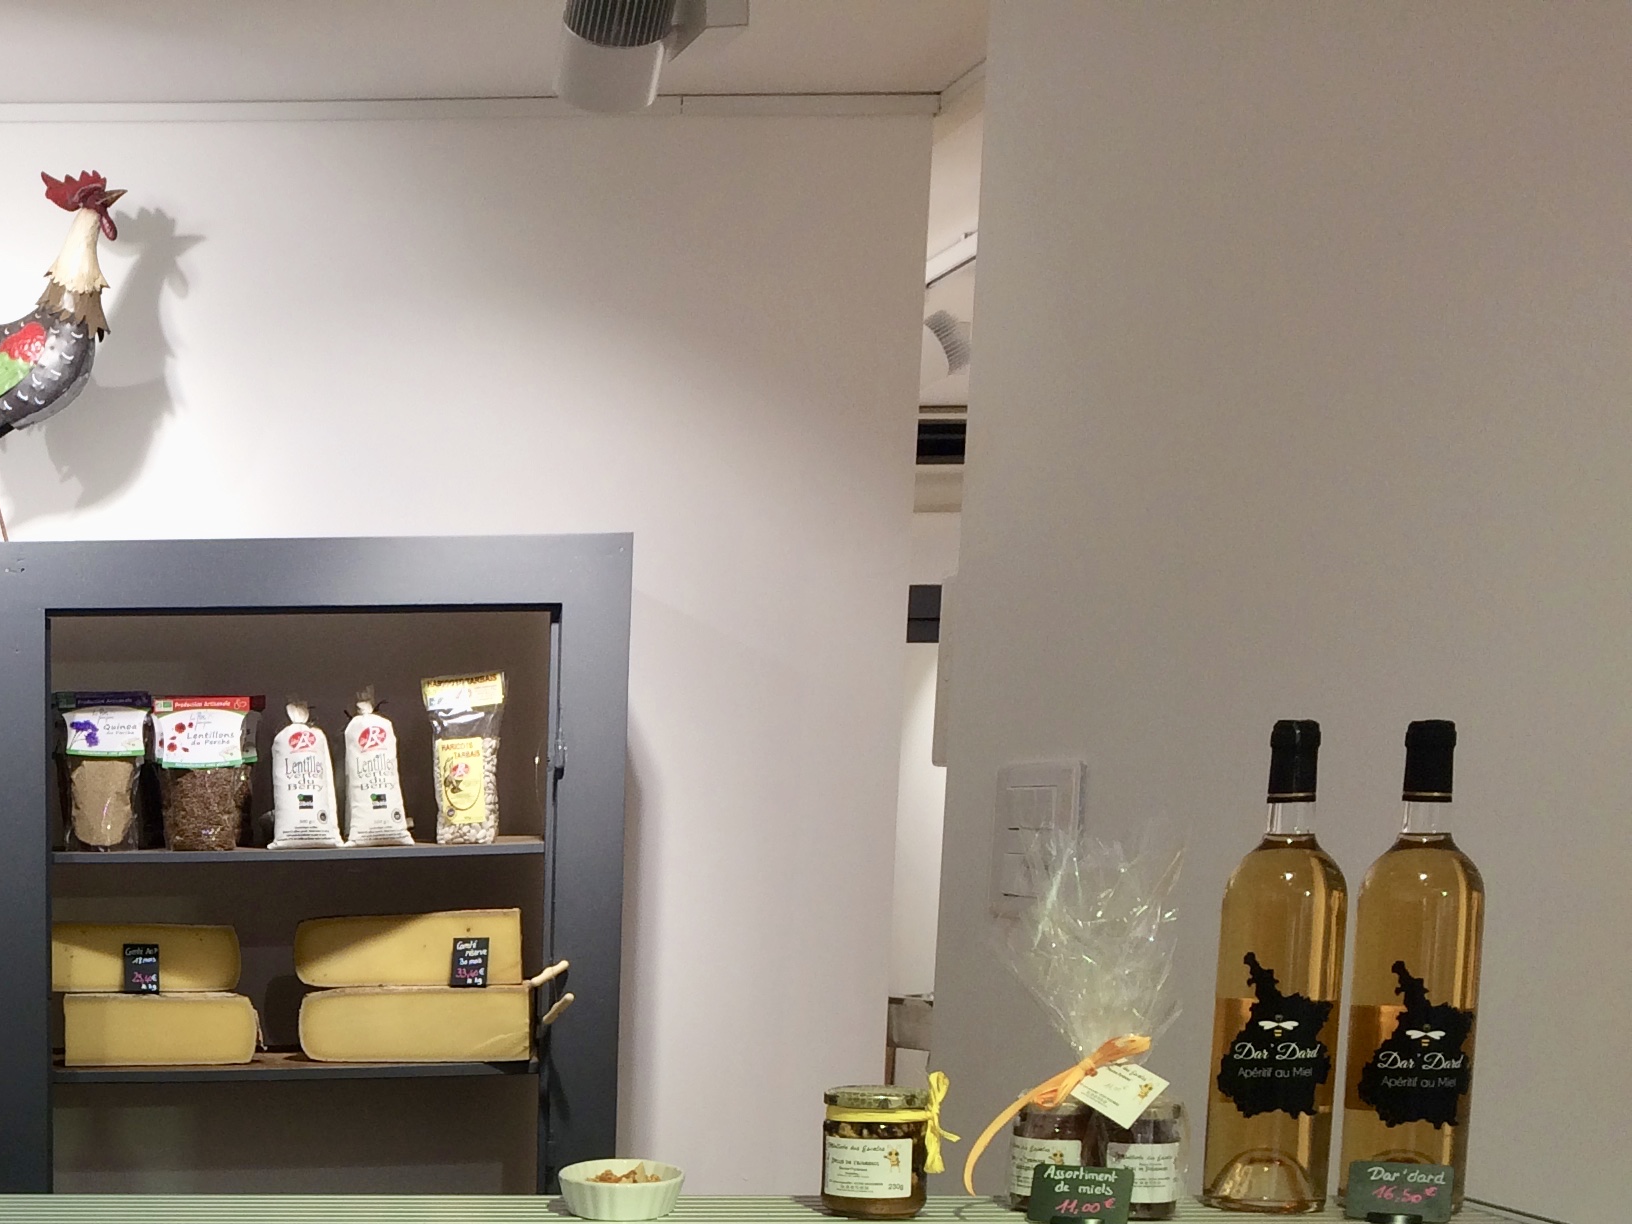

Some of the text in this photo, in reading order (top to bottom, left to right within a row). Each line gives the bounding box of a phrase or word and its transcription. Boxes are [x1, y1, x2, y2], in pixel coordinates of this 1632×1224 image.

[186, 732, 235, 740] Lentillons
[285, 756, 324, 774] Lentilles
[356, 754, 395, 775] Lentilles
[287, 783, 324, 791] Berry
[1276, 1042, 1321, 1060] Dard
[1421, 1052, 1464, 1070] Dard
[1238, 1066, 1312, 1079] Apéritif au Miel
[1381, 1076, 1456, 1088] Apéritif au Miel
[1043, 1165, 1118, 1183] Assortiment
[1055, 1182, 1113, 1195] de miels
[1055, 1199, 1101, 1214] 11,00
